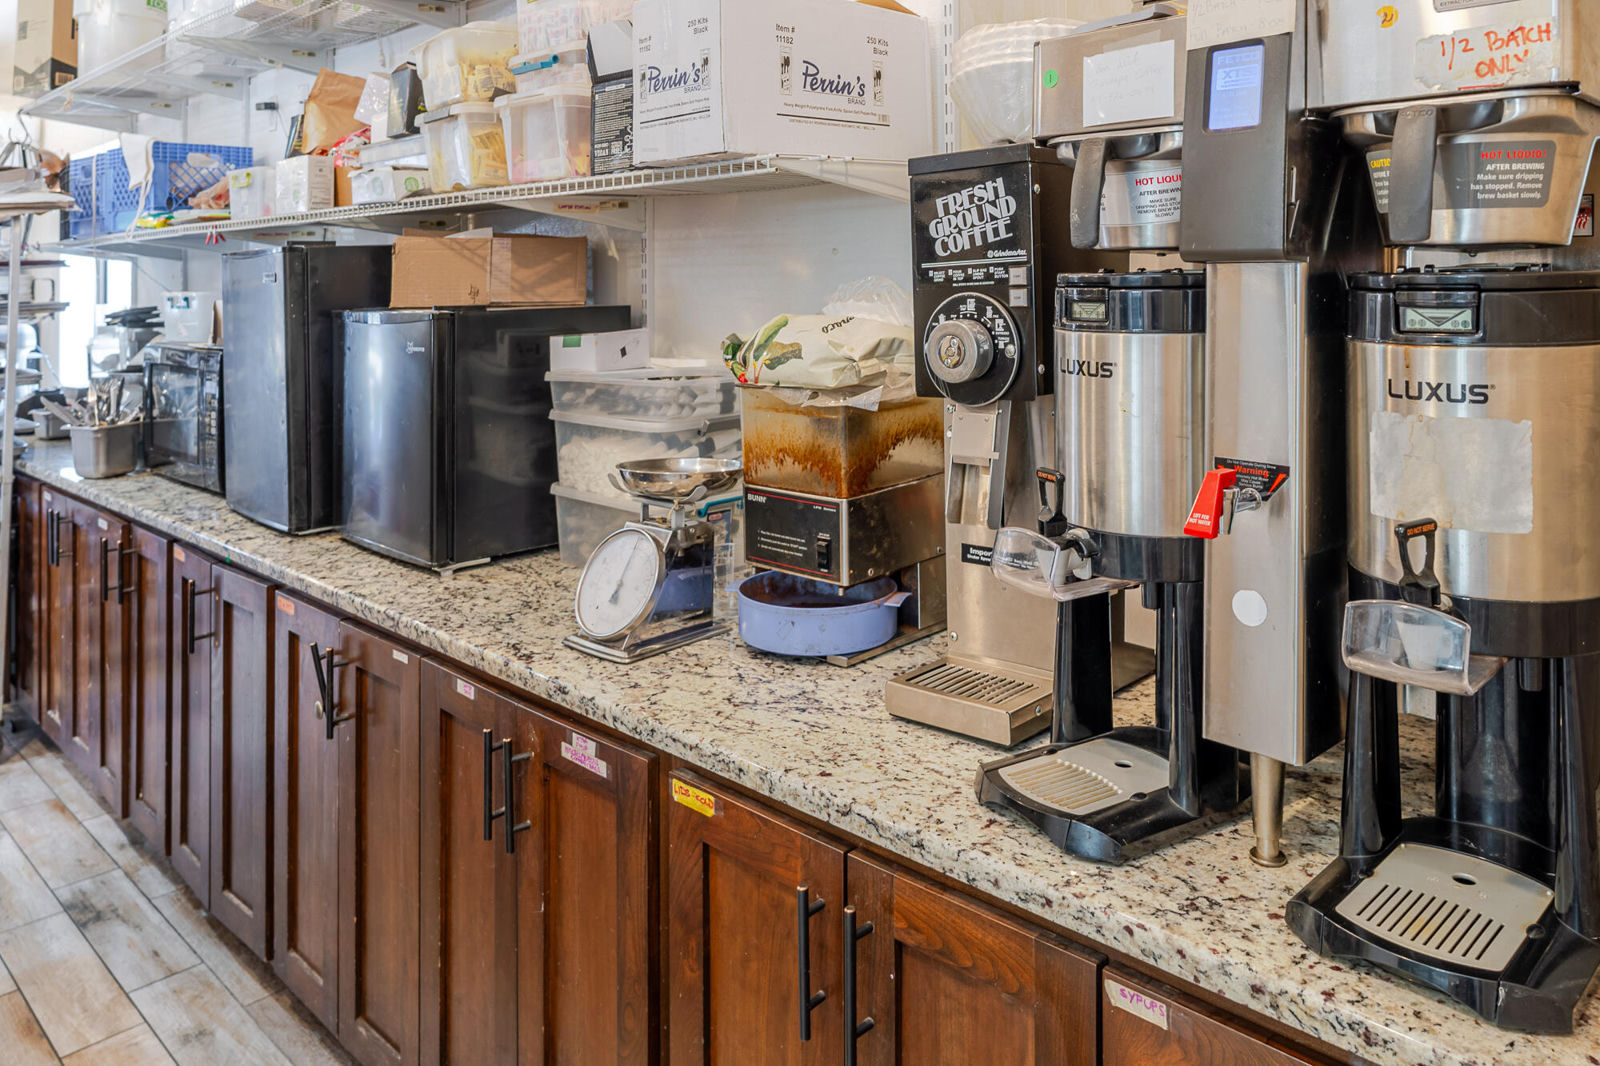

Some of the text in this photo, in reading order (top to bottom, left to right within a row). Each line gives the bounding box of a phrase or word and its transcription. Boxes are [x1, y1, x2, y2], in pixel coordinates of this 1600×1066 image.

[775, 23, 790, 33] Item
[775, 34, 794, 45] 11182
[1440, 21, 1552, 71] 1/2 BATCH
[872, 47, 889, 57] Black
[1474, 49, 1529, 78] ONLY
[647, 62, 701, 94] Perrin's
[802, 60, 866, 97] Perrin's
[847, 97, 866, 106] BRAND
[1481, 149, 1547, 160] HOT LIQUID!
[1486, 162, 1545, 171] AFTER BREWING
[1135, 173, 1183, 186] HOT LIQUI
[1515, 172, 1544, 181] dripping
[935, 176, 1006, 219] FRESH
[928, 195, 1017, 239] GROUND
[934, 216, 1013, 257] COFFEE
[1233, 464, 1270, 478] Warning
[747, 493, 767, 504] BUNN
